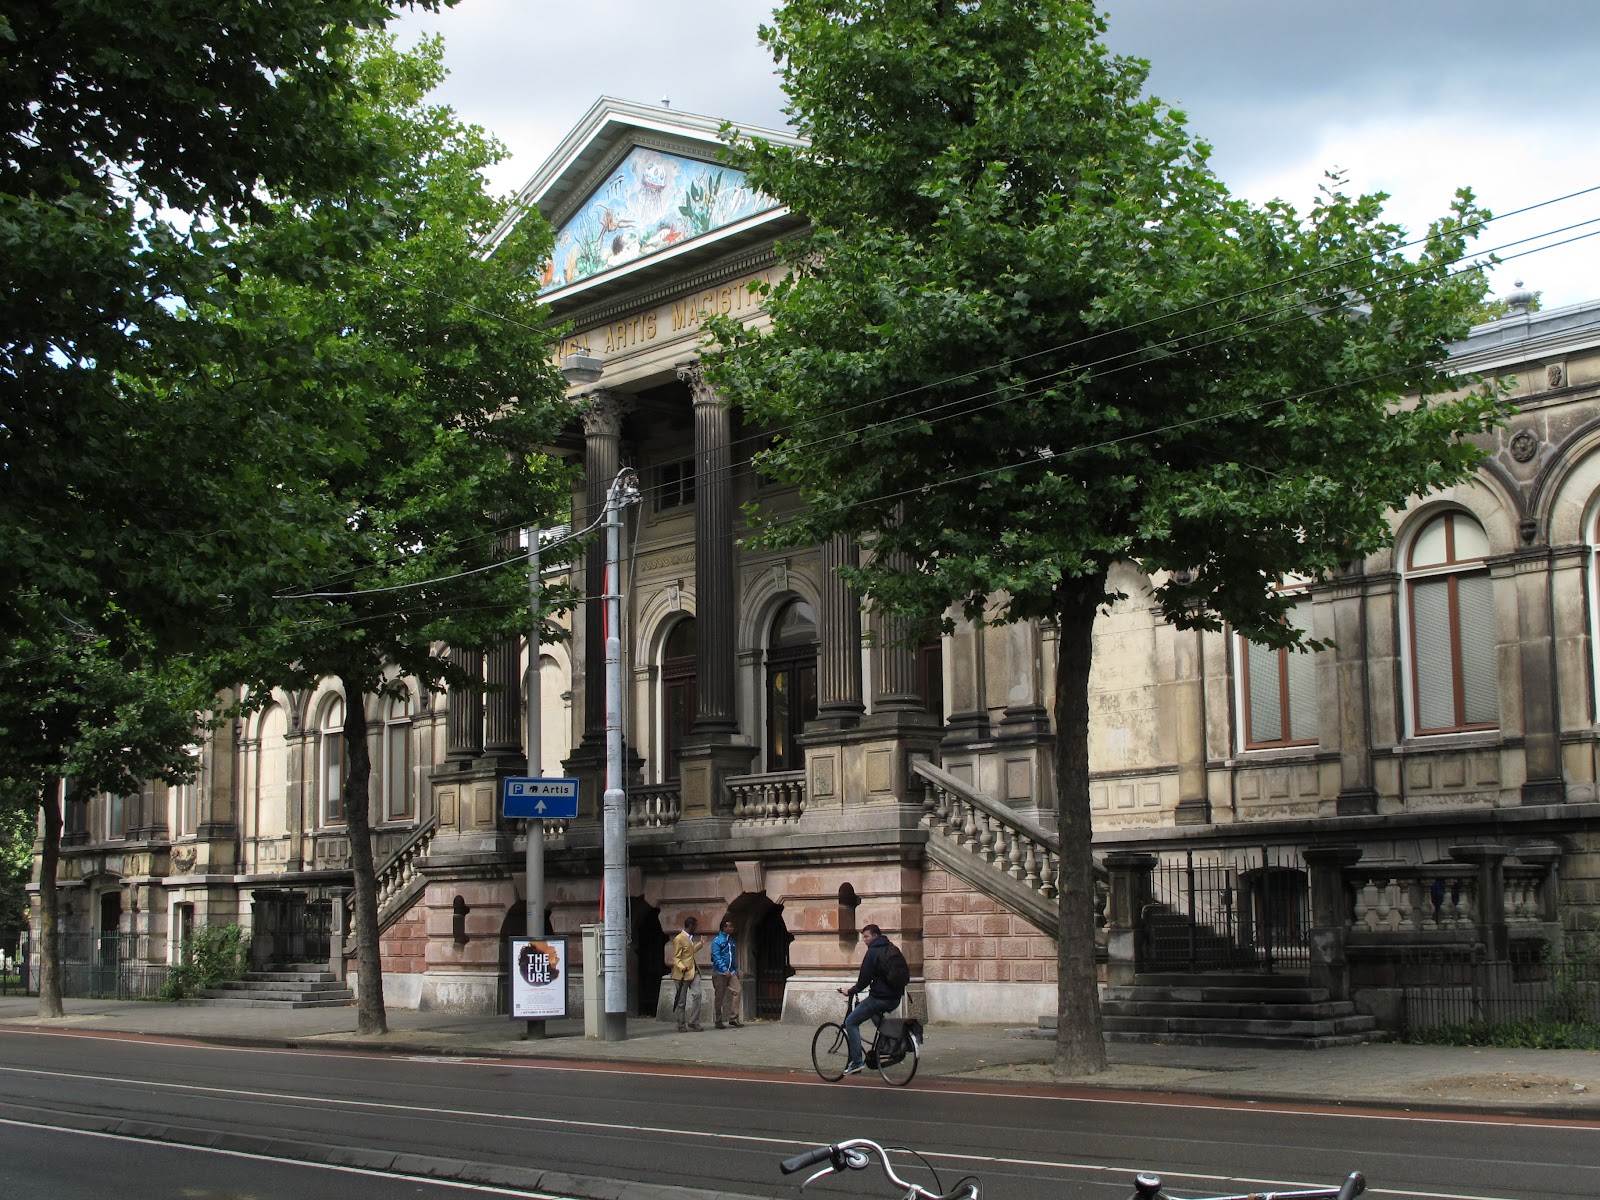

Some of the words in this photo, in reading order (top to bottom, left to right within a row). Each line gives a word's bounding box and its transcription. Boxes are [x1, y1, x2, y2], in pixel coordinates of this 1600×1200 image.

[604, 313, 657, 353] ARTIS
[514, 784, 522, 793] P
[542, 785, 569, 794] Artis
[527, 954, 550, 964] THE
[527, 963, 550, 973] FUT
[527, 973, 551, 983] URE
